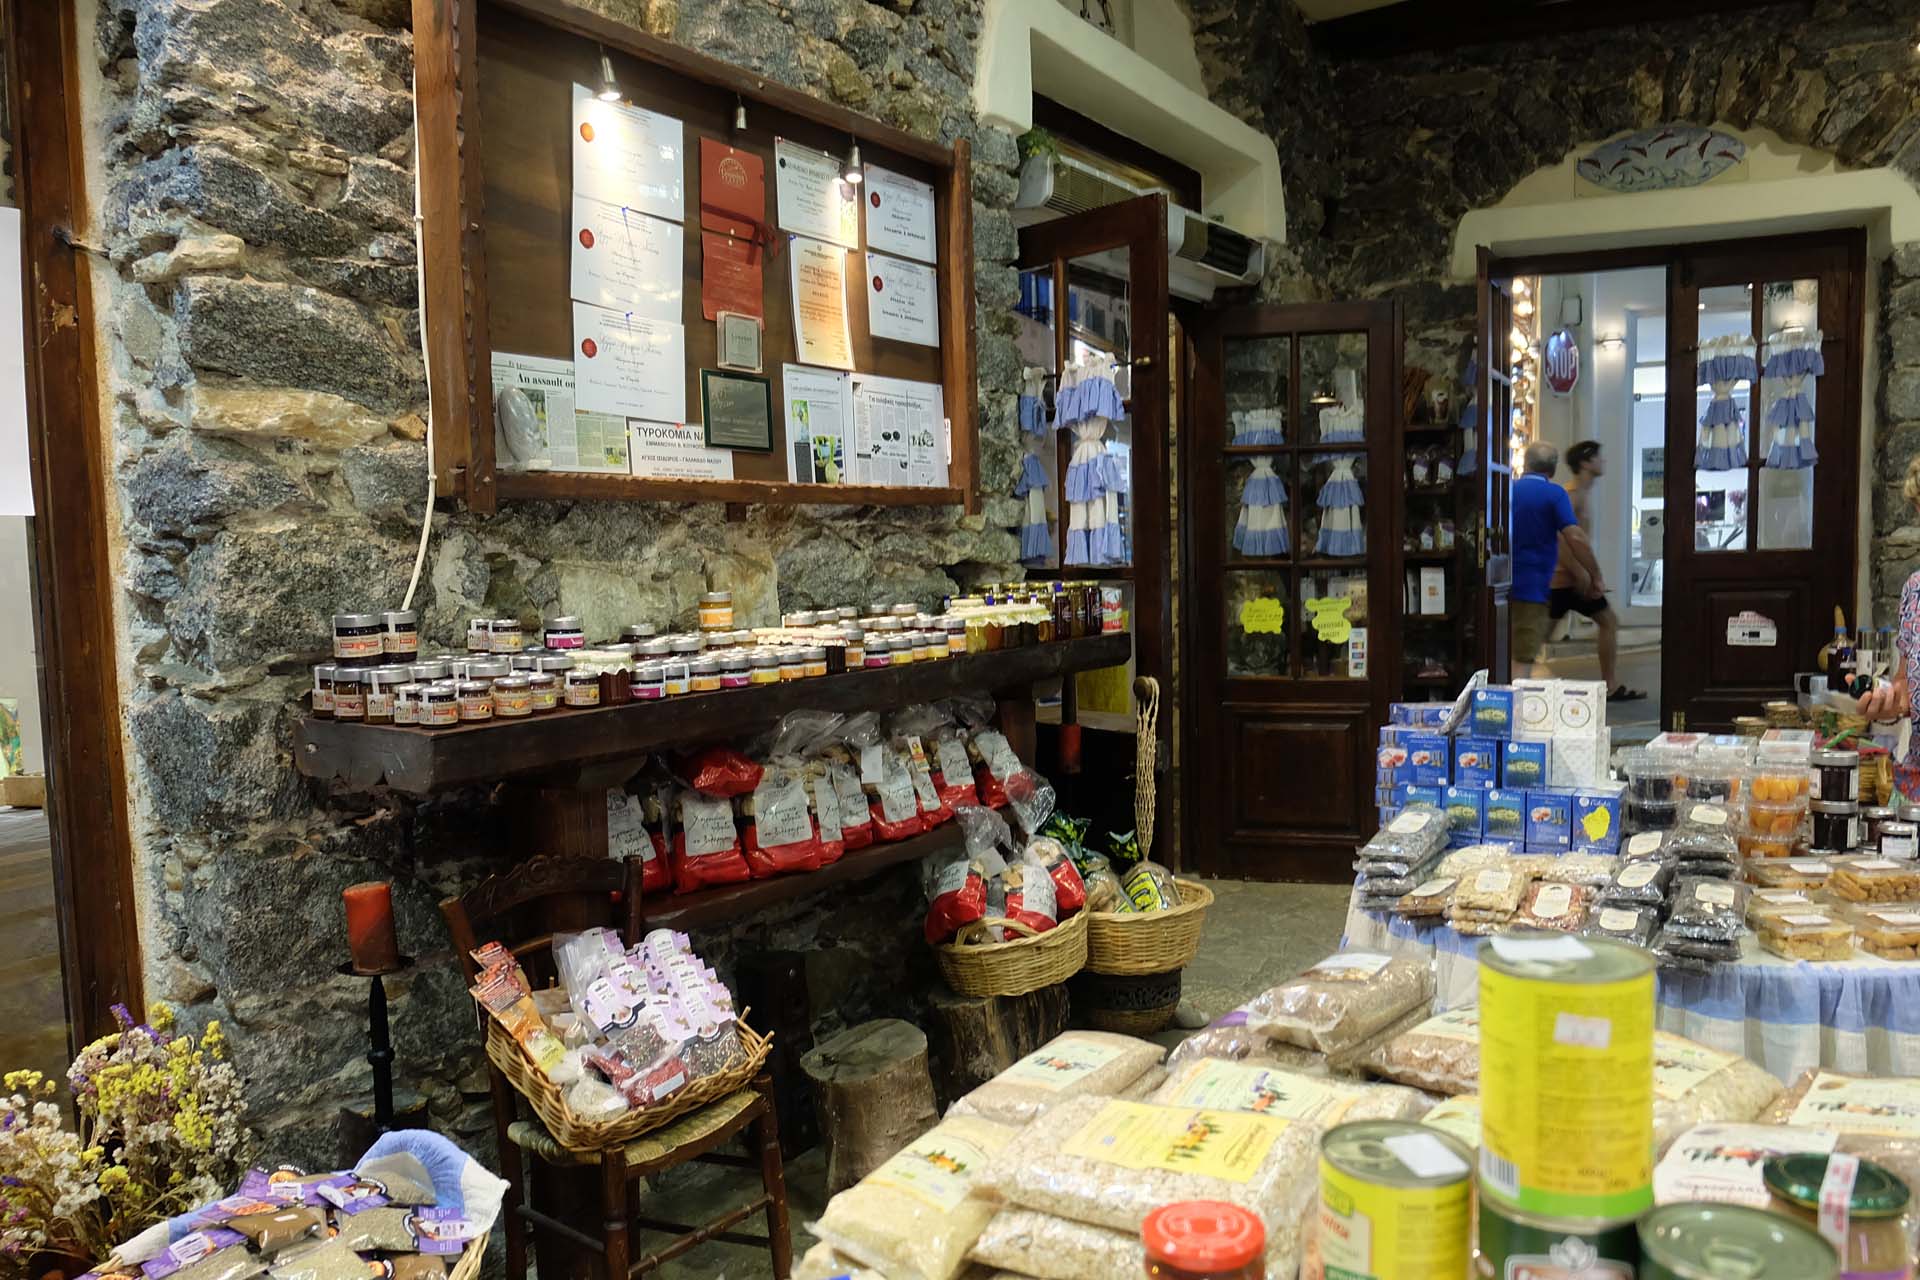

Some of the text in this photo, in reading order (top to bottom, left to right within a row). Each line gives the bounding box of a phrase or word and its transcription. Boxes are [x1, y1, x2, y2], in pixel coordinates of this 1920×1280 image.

[1547, 347, 1576, 380] STOP
[517, 373, 530, 384] An
[532, 376, 563, 388] assault
[636, 427, 692, 441] ΤΥΡΟΚΟΜΙΑ
